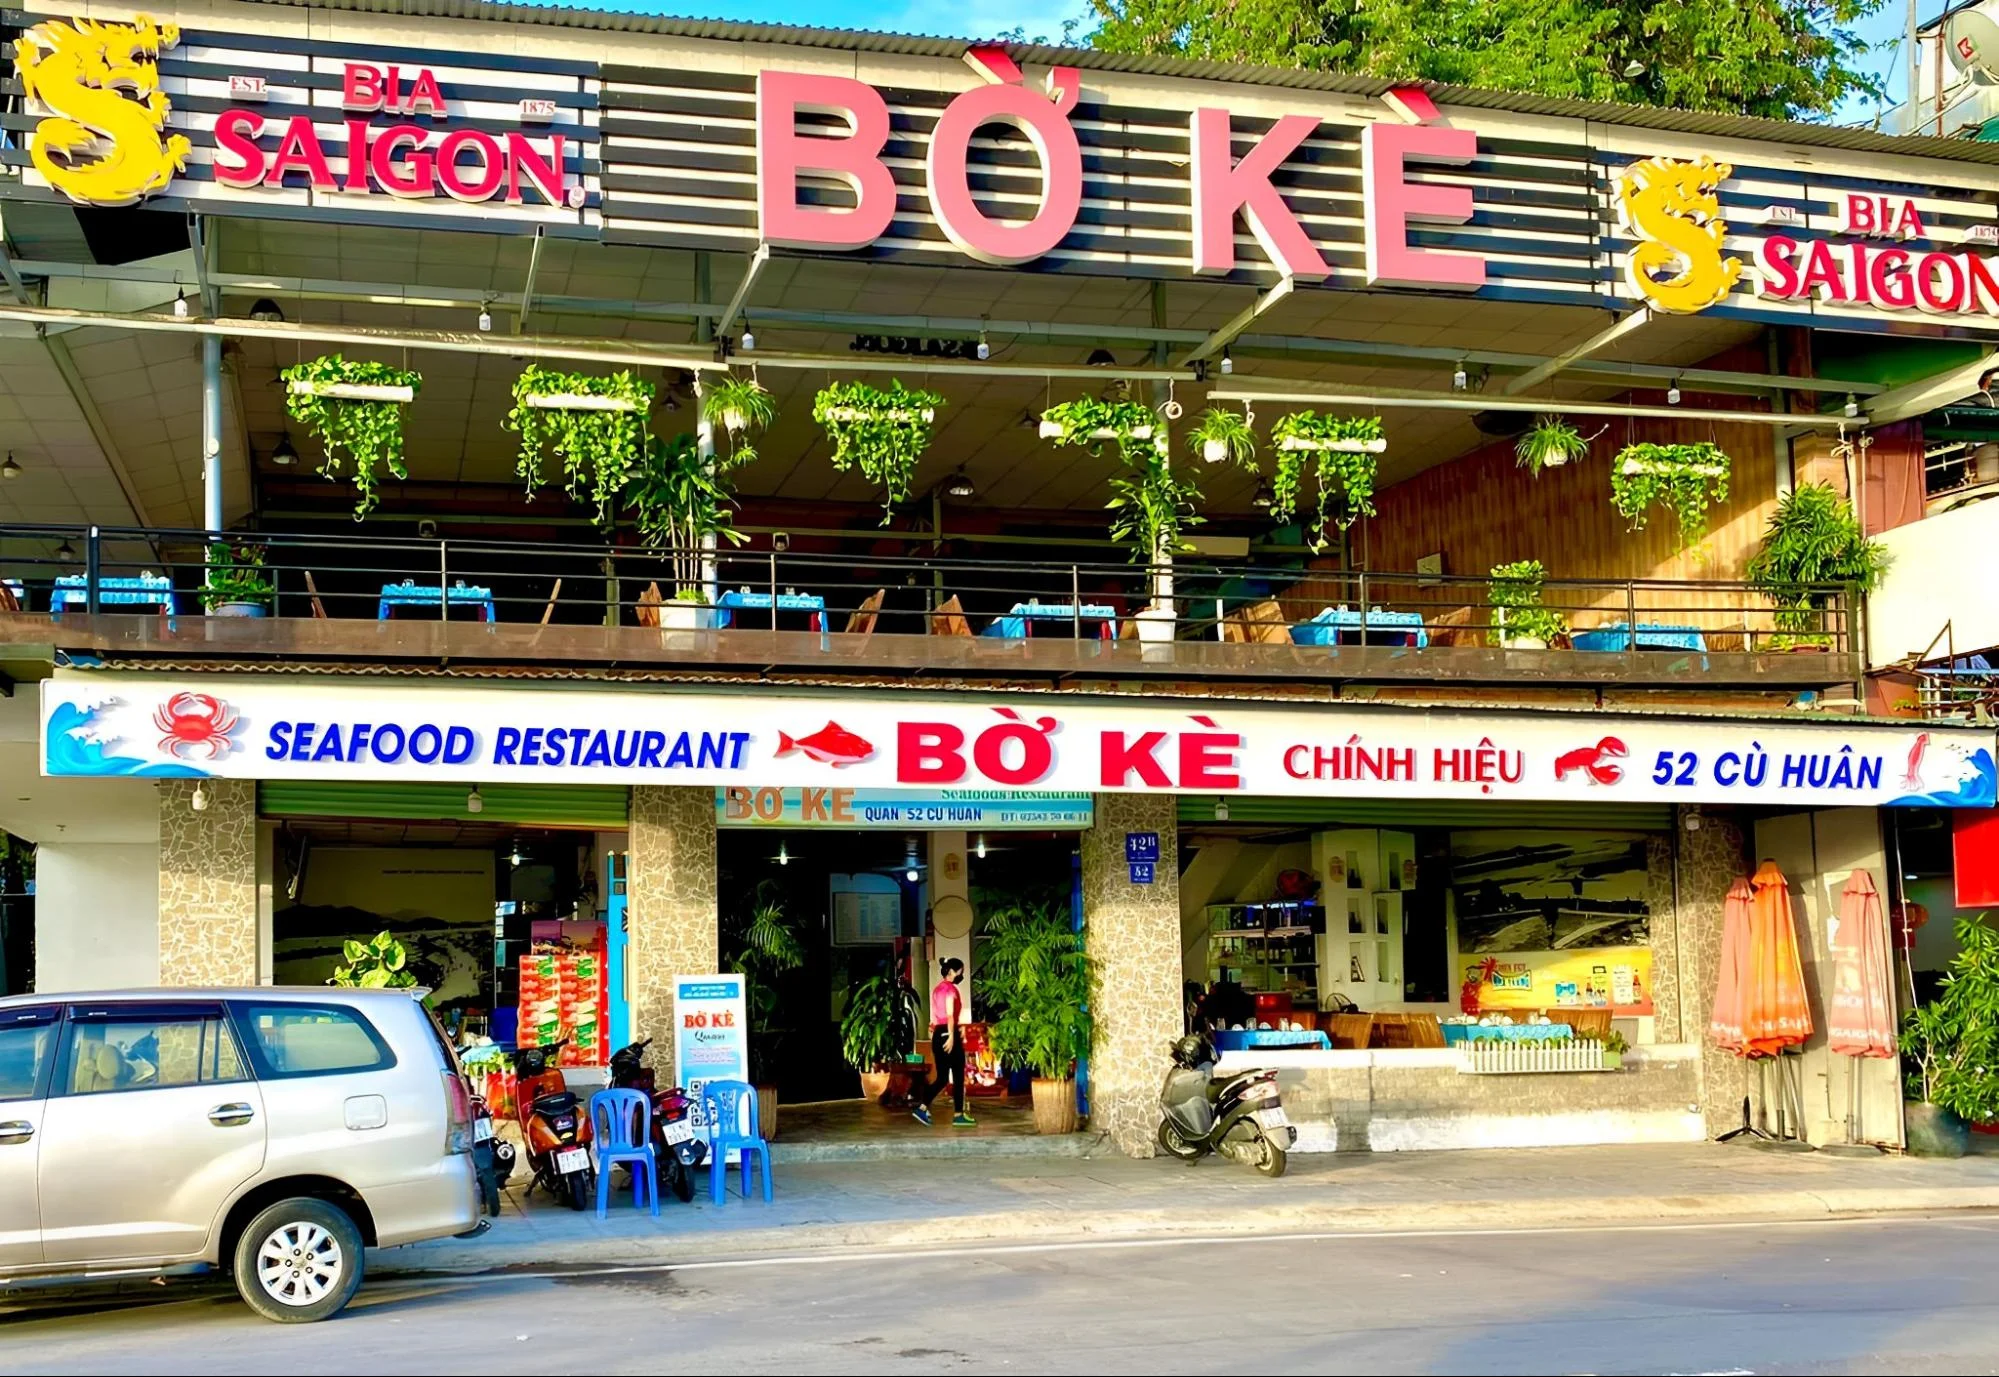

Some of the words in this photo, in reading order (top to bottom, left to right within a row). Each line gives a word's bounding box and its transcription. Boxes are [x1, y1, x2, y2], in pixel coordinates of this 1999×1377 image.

[342, 63, 446, 114] BIA
[522, 101, 555, 113] 1875
[212, 108, 566, 205] SAIGON
[757, 43, 1083, 262] BỜ
[1193, 85, 1486, 289] KÈ
[1847, 194, 1927, 236] BIA
[265, 721, 474, 764] SEAFOOD
[493, 727, 750, 768] RESTAURANT
[897, 707, 1057, 786] BỜ
[1100, 716, 1240, 788] KÈ
[1283, 734, 1414, 781] CHÍNH
[1434, 737, 1523, 793] HIỆU
[1653, 752, 1698, 785] 52
[1714, 741, 1768, 787] CÙ
[1782, 745, 1883, 789] HUÂN
[907, 808, 923, 820] 52
